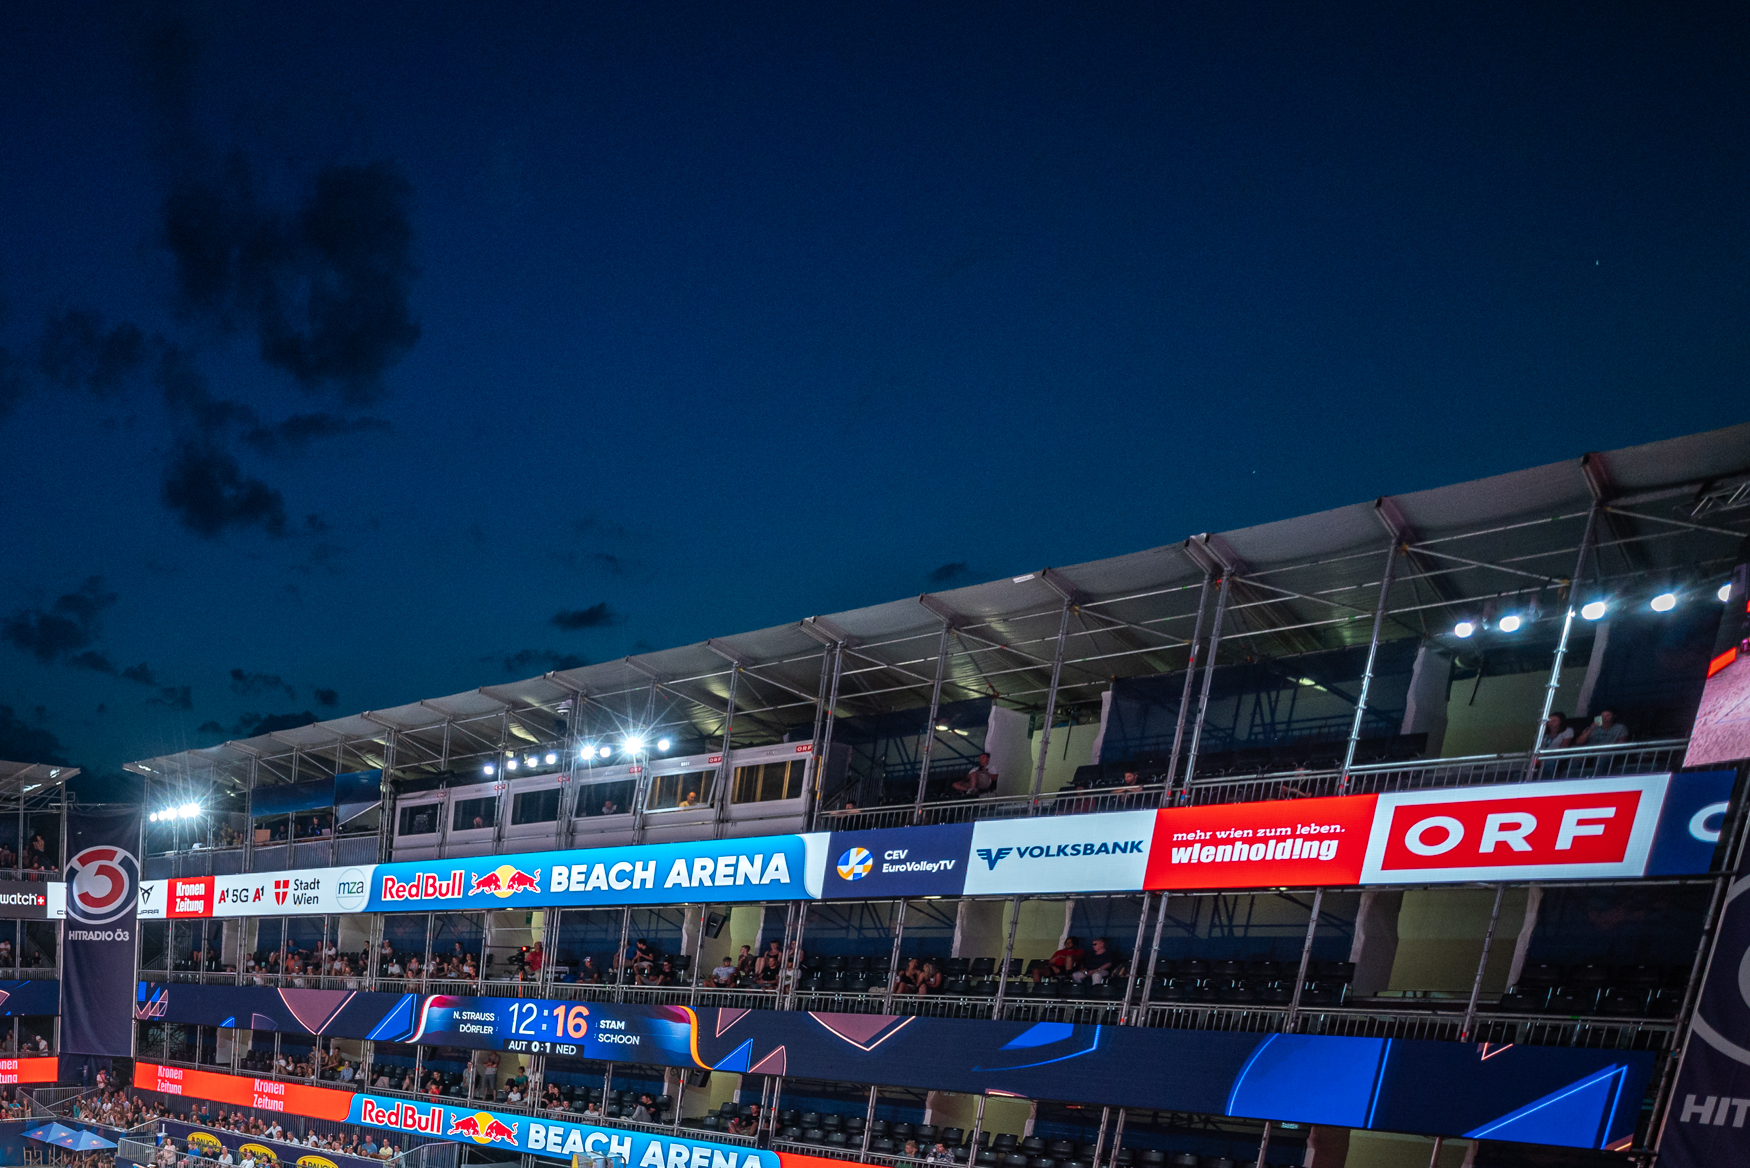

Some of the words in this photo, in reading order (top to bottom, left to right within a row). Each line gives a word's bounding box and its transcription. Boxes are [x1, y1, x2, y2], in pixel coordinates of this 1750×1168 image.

[1172, 829, 1213, 842] mehr
[1215, 827, 1253, 839] wien
[1256, 826, 1292, 837] zum
[1295, 822, 1346, 835] leben.
[1404, 806, 1617, 857] ORF
[884, 849, 908, 860] CEV
[1016, 839, 1145, 859] VOLKSBANK
[550, 859, 657, 894] BEACH
[664, 852, 791, 889] ARENA
[882, 859, 956, 874] EuroVolleyTV
[176, 881, 205, 897] Kronen
[293, 878, 320, 891] Stadt
[338, 880, 364, 894] mza
[382, 874, 422, 900] Red
[422, 870, 464, 899] Bull
[218, 887, 230, 904] A1
[231, 888, 249, 903] 5G
[253, 885, 264, 903] A1
[293, 893, 319, 905] Wien
[175, 898, 204, 913] Zeitung
[68, 930, 114, 941] HITRADIO
[114, 929, 130, 942] Ö3
[453, 1011, 461, 1020] N.
[462, 1011, 495, 1022] STRAUSS
[599, 1019, 625, 1030] STAM
[459, 1022, 493, 1035] DÖRFLER
[597, 1032, 641, 1045] SCHOON
[508, 1039, 527, 1051] AUT
[556, 1044, 577, 1056] NED
[157, 1064, 183, 1080] Kronen
[156, 1079, 182, 1095] Zeitung
[253, 1078, 285, 1096] Kronen
[252, 1093, 284, 1112] Zeitung
[361, 1099, 402, 1126] Red
[400, 1104, 444, 1135] Bull
[527, 1123, 633, 1165] BEACH
